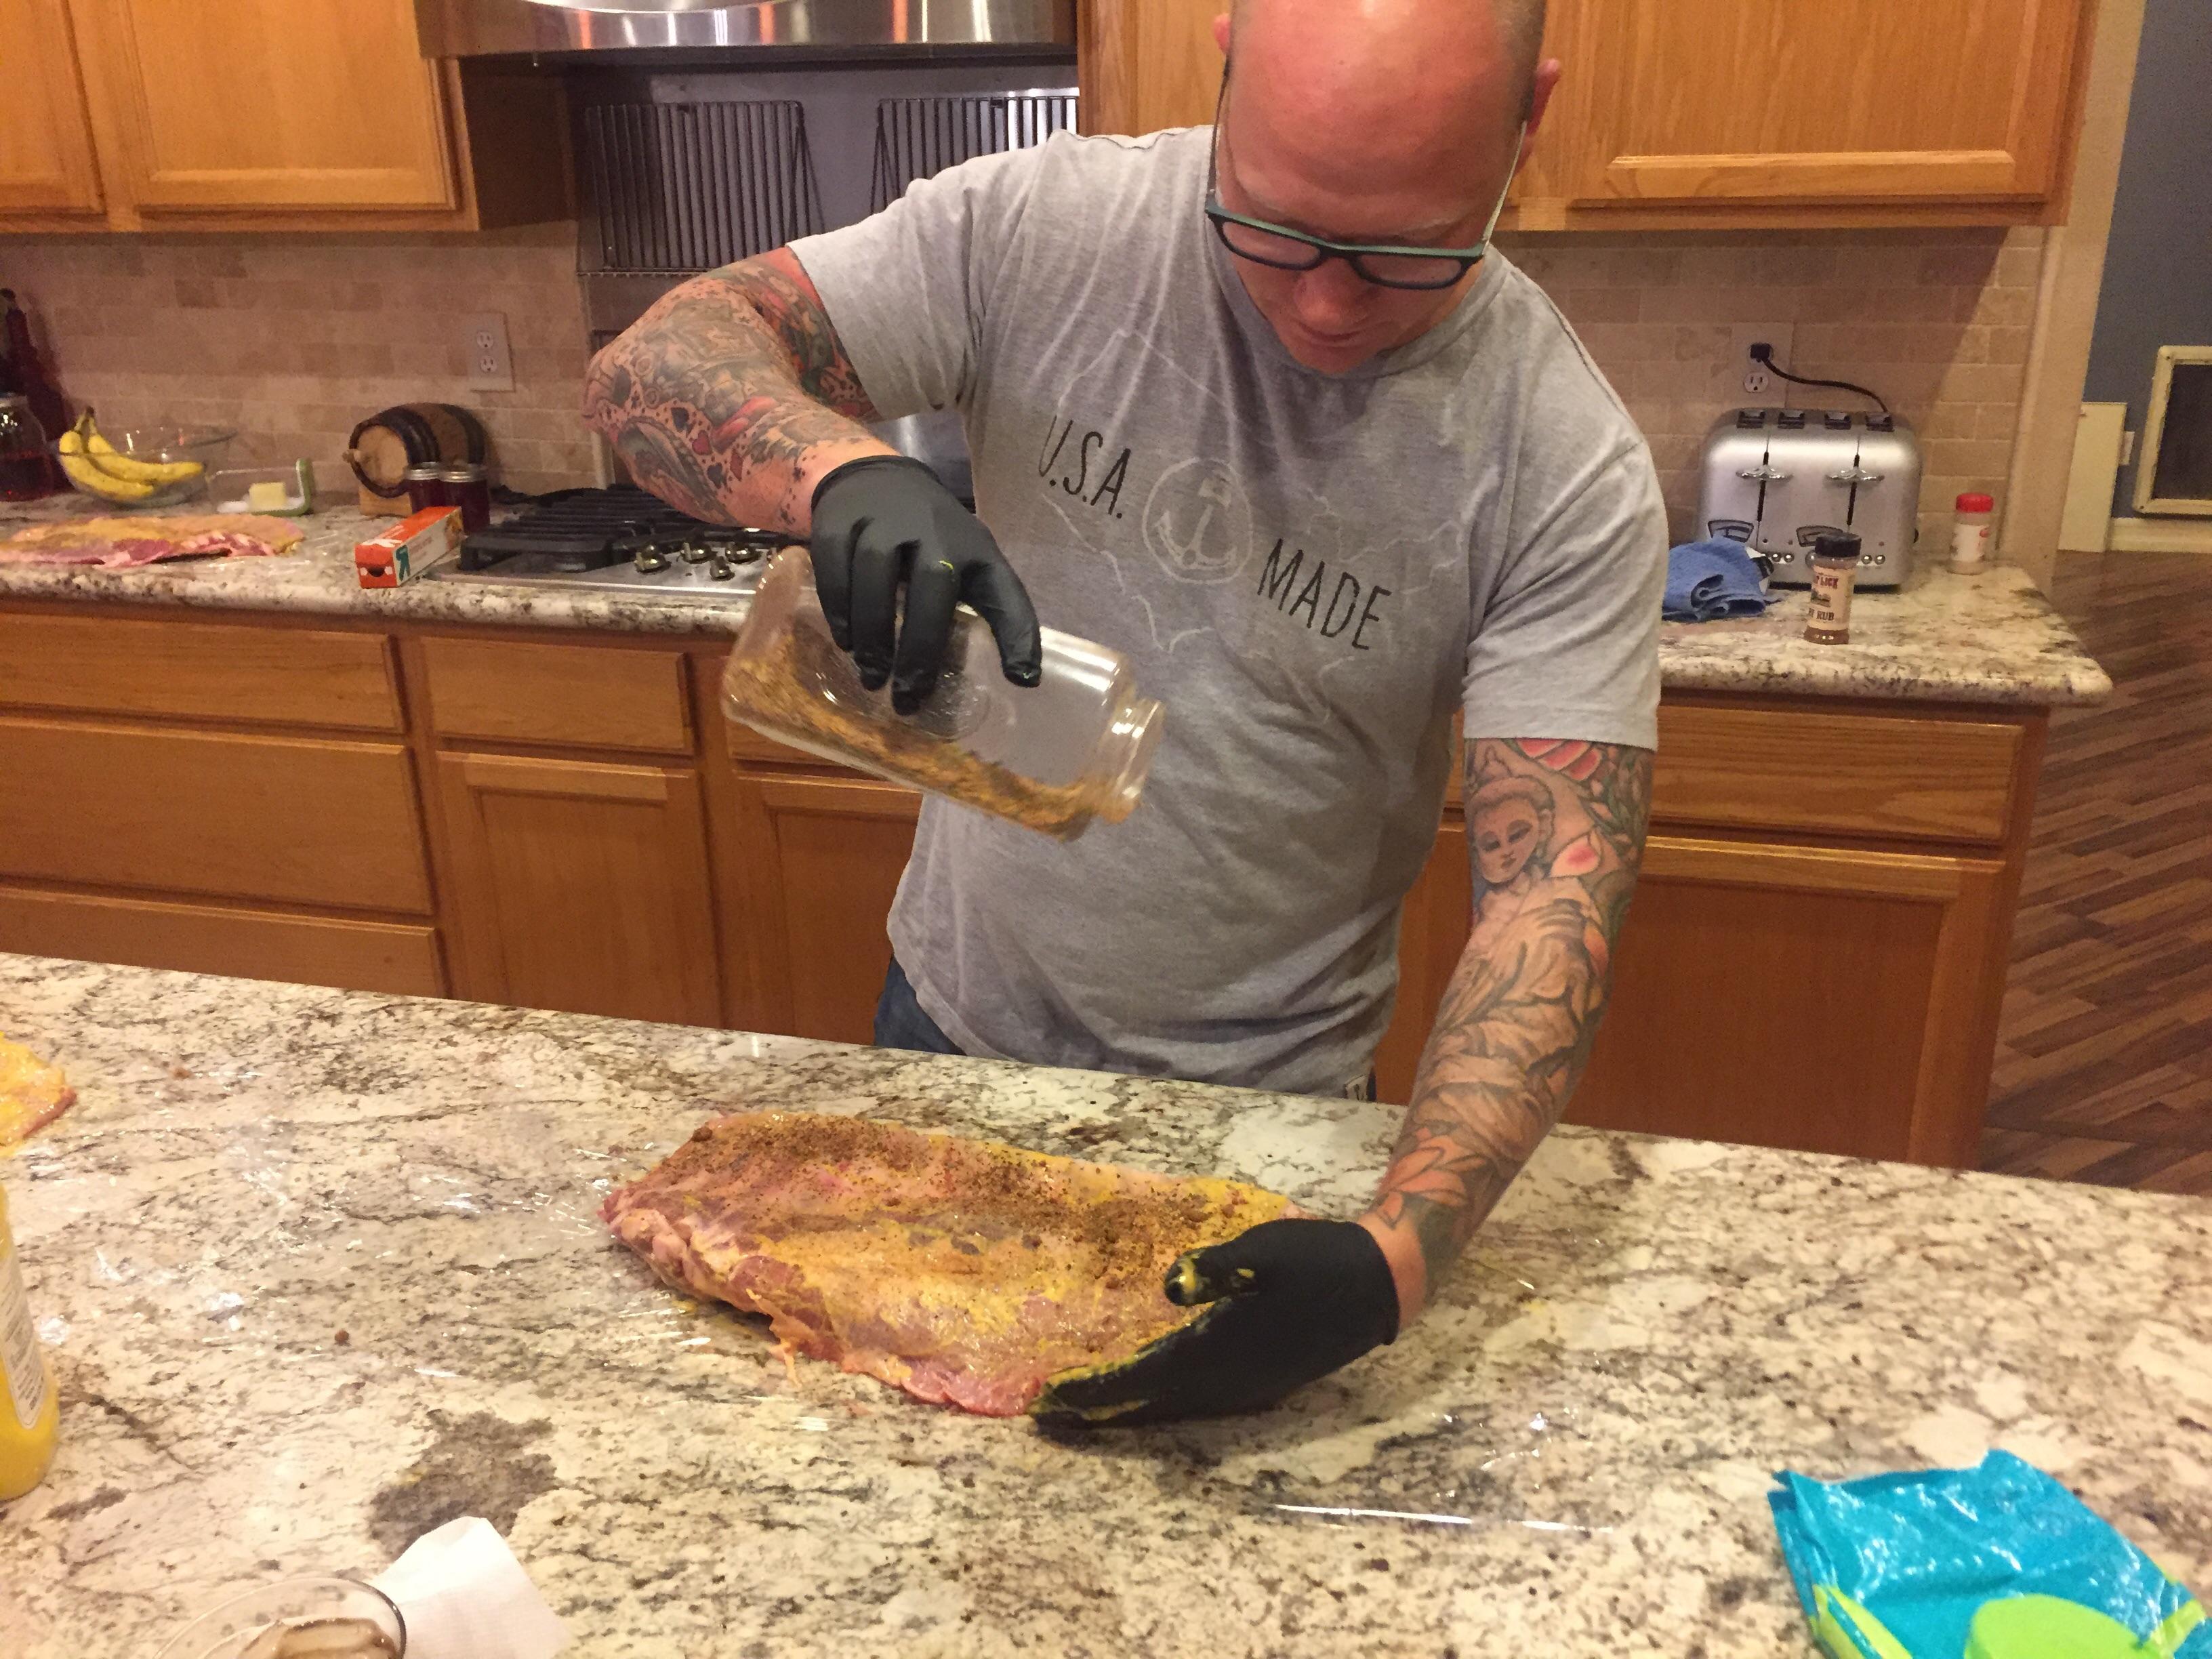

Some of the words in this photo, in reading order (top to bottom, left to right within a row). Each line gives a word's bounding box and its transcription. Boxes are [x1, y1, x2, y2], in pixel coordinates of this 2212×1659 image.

[1038, 414, 1132, 519] U.S.A.
[1257, 538, 1392, 651] MADE
[1816, 611, 1835, 620] RUB
